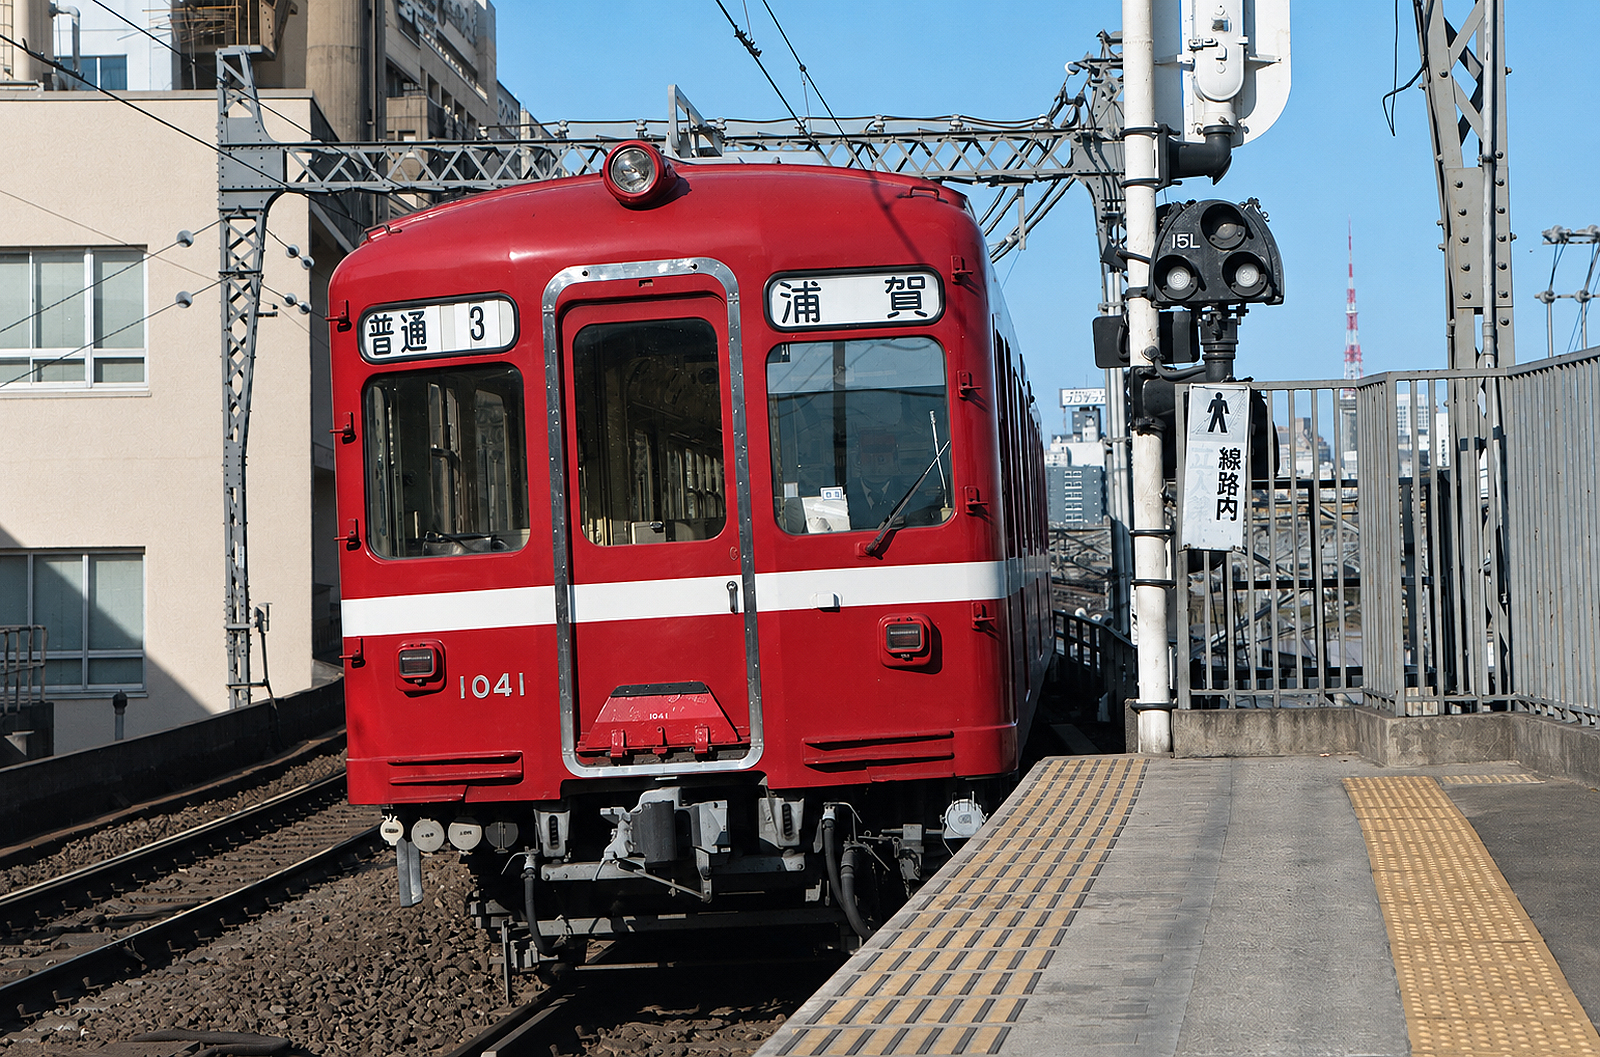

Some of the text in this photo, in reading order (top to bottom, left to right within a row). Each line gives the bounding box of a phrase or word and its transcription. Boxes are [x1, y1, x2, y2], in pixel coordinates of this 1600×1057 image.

[1172, 233, 1201, 249] 15L
[780, 275, 928, 324] 浦賀
[368, 306, 485, 355] 普通 3
[1216, 447, 1242, 521] 線路内
[459, 672, 525, 699] 1041
[649, 712, 668, 720] 1041
